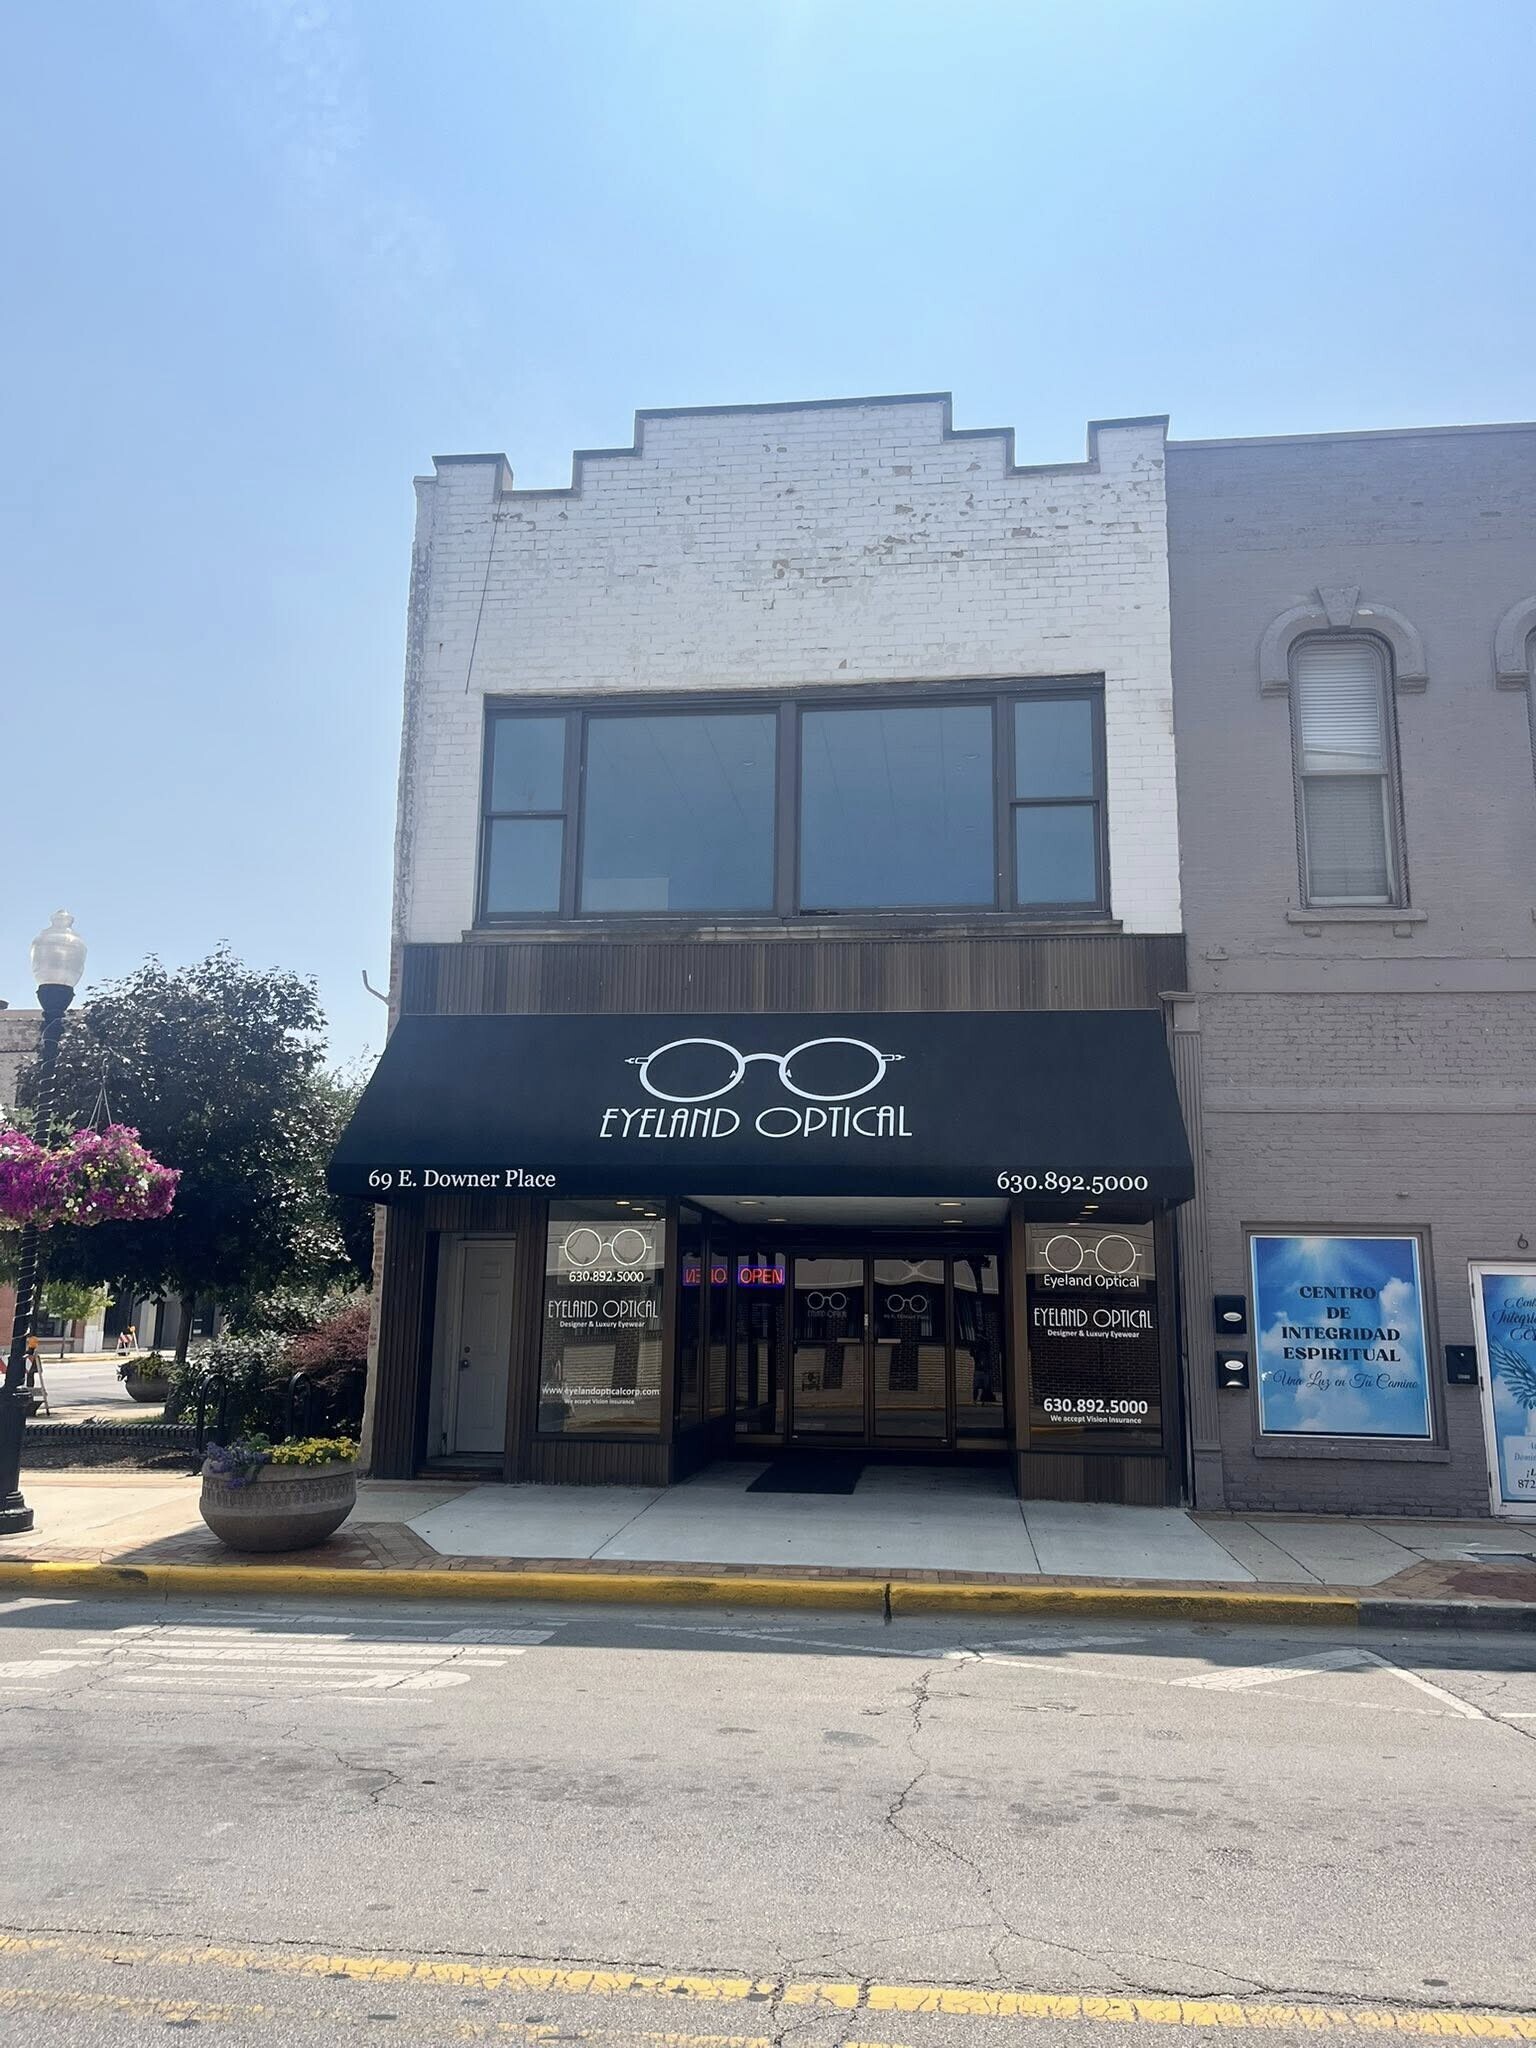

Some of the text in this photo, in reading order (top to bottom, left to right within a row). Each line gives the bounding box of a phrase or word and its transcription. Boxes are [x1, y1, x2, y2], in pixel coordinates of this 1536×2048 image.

[599, 1105, 913, 1139] EYELAND OPTICAL
[368, 1168, 557, 1191] 69 E. Downer Place
[996, 1170, 1149, 1195] 630.892.5000
[568, 1270, 645, 1283] 630.892.5000
[740, 1267, 783, 1284] OPEN
[1043, 1274, 1140, 1290] Eyeland Optical
[1299, 1285, 1377, 1300] CENTRO
[547, 1299, 659, 1319] EYELAND OPTICAL
[1326, 1306, 1352, 1320] DE
[559, 1320, 646, 1329] Designer & Luxury Eyewear
[1033, 1307, 1154, 1329] EYELAND OPTICAL
[1047, 1329, 1078, 1338] Designer
[1086, 1330, 1110, 1339] Luxury
[1110, 1331, 1140, 1339] Eyewear
[1281, 1326, 1401, 1342] INTEGRIDAD
[1283, 1346, 1401, 1362] ESPIRITUAL
[1272, 1368, 1303, 1388] Una
[1306, 1370, 1332, 1391] Luz
[1334, 1378, 1347, 1388] en
[1375, 1373, 1419, 1389] Camino
[541, 1385, 661, 1397] www.eyelandopticalcorp.com
[1043, 1398, 1149, 1414] 630.892.5000
[1050, 1414, 1062, 1422] We
[1062, 1416, 1085, 1424] accept
